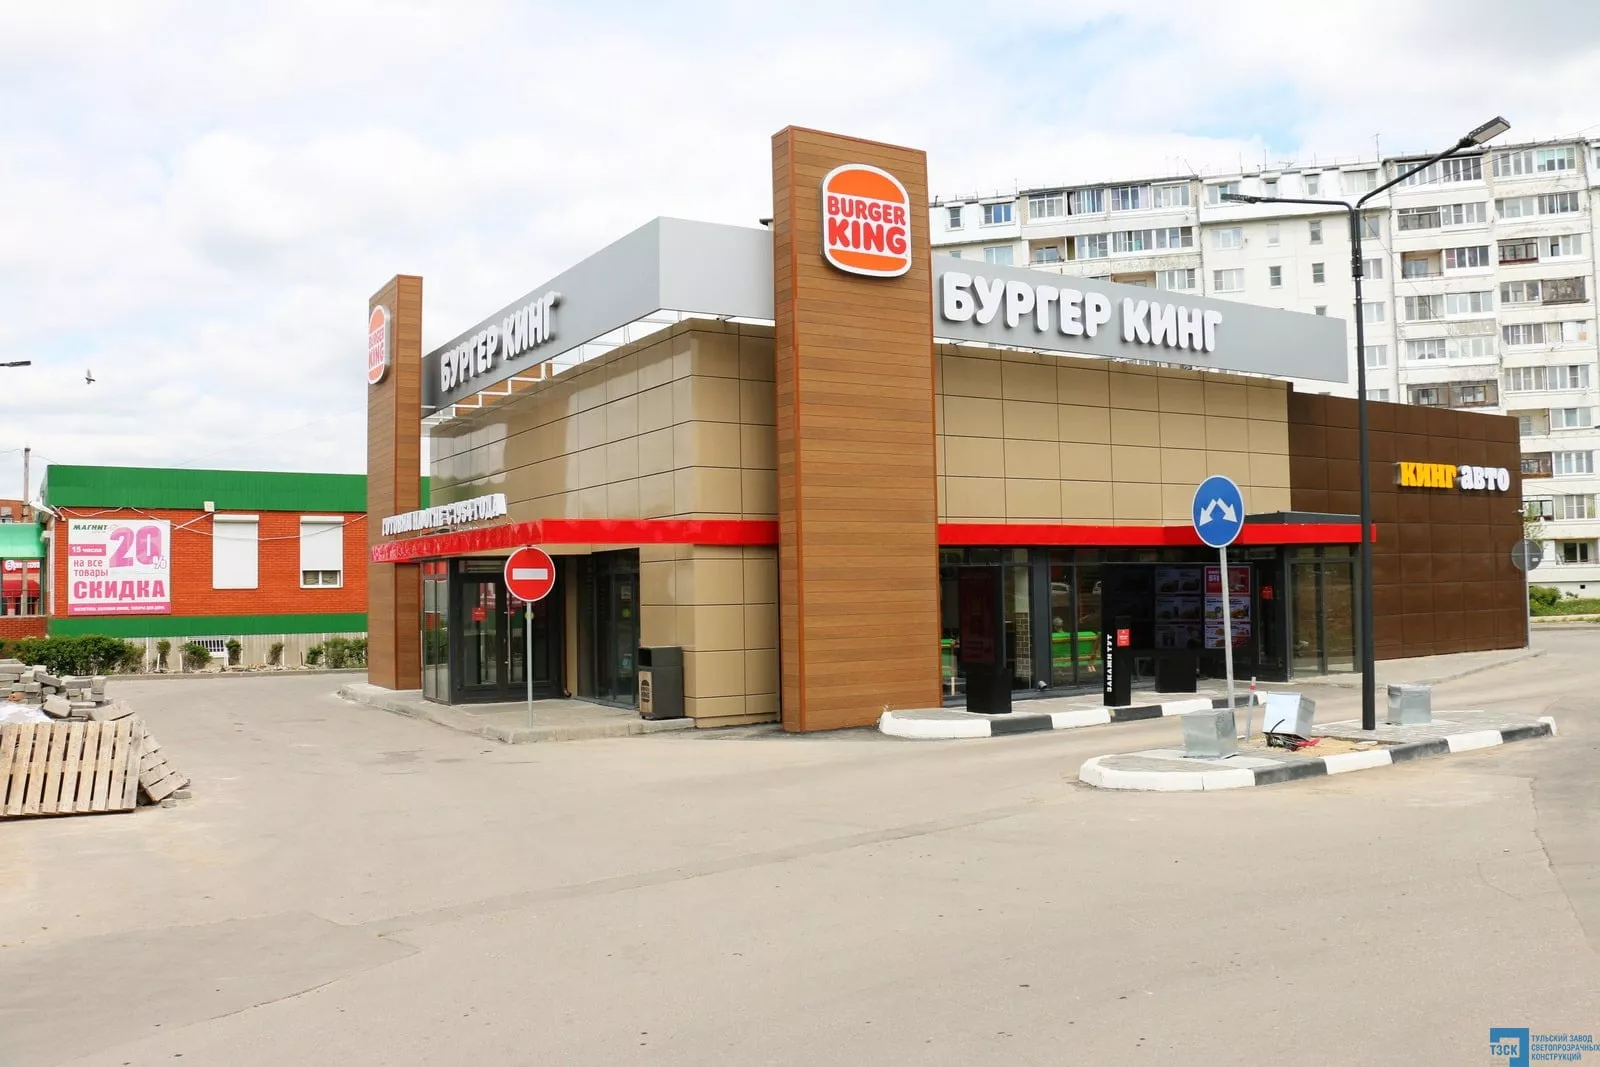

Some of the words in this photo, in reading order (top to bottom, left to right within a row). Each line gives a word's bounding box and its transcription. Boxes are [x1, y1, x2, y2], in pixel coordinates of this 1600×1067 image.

[828, 196, 905, 225] BURGER
[828, 217, 906, 254] KING
[943, 271, 1111, 337] БУРГЕР
[1121, 297, 1223, 352] КИНГ
[441, 324, 500, 392] БУРГЕР
[502, 291, 561, 361] КИНГ
[1400, 462, 1457, 488] КИНГ
[74, 569, 108, 578] товары
[74, 580, 165, 600] СКИДКА
